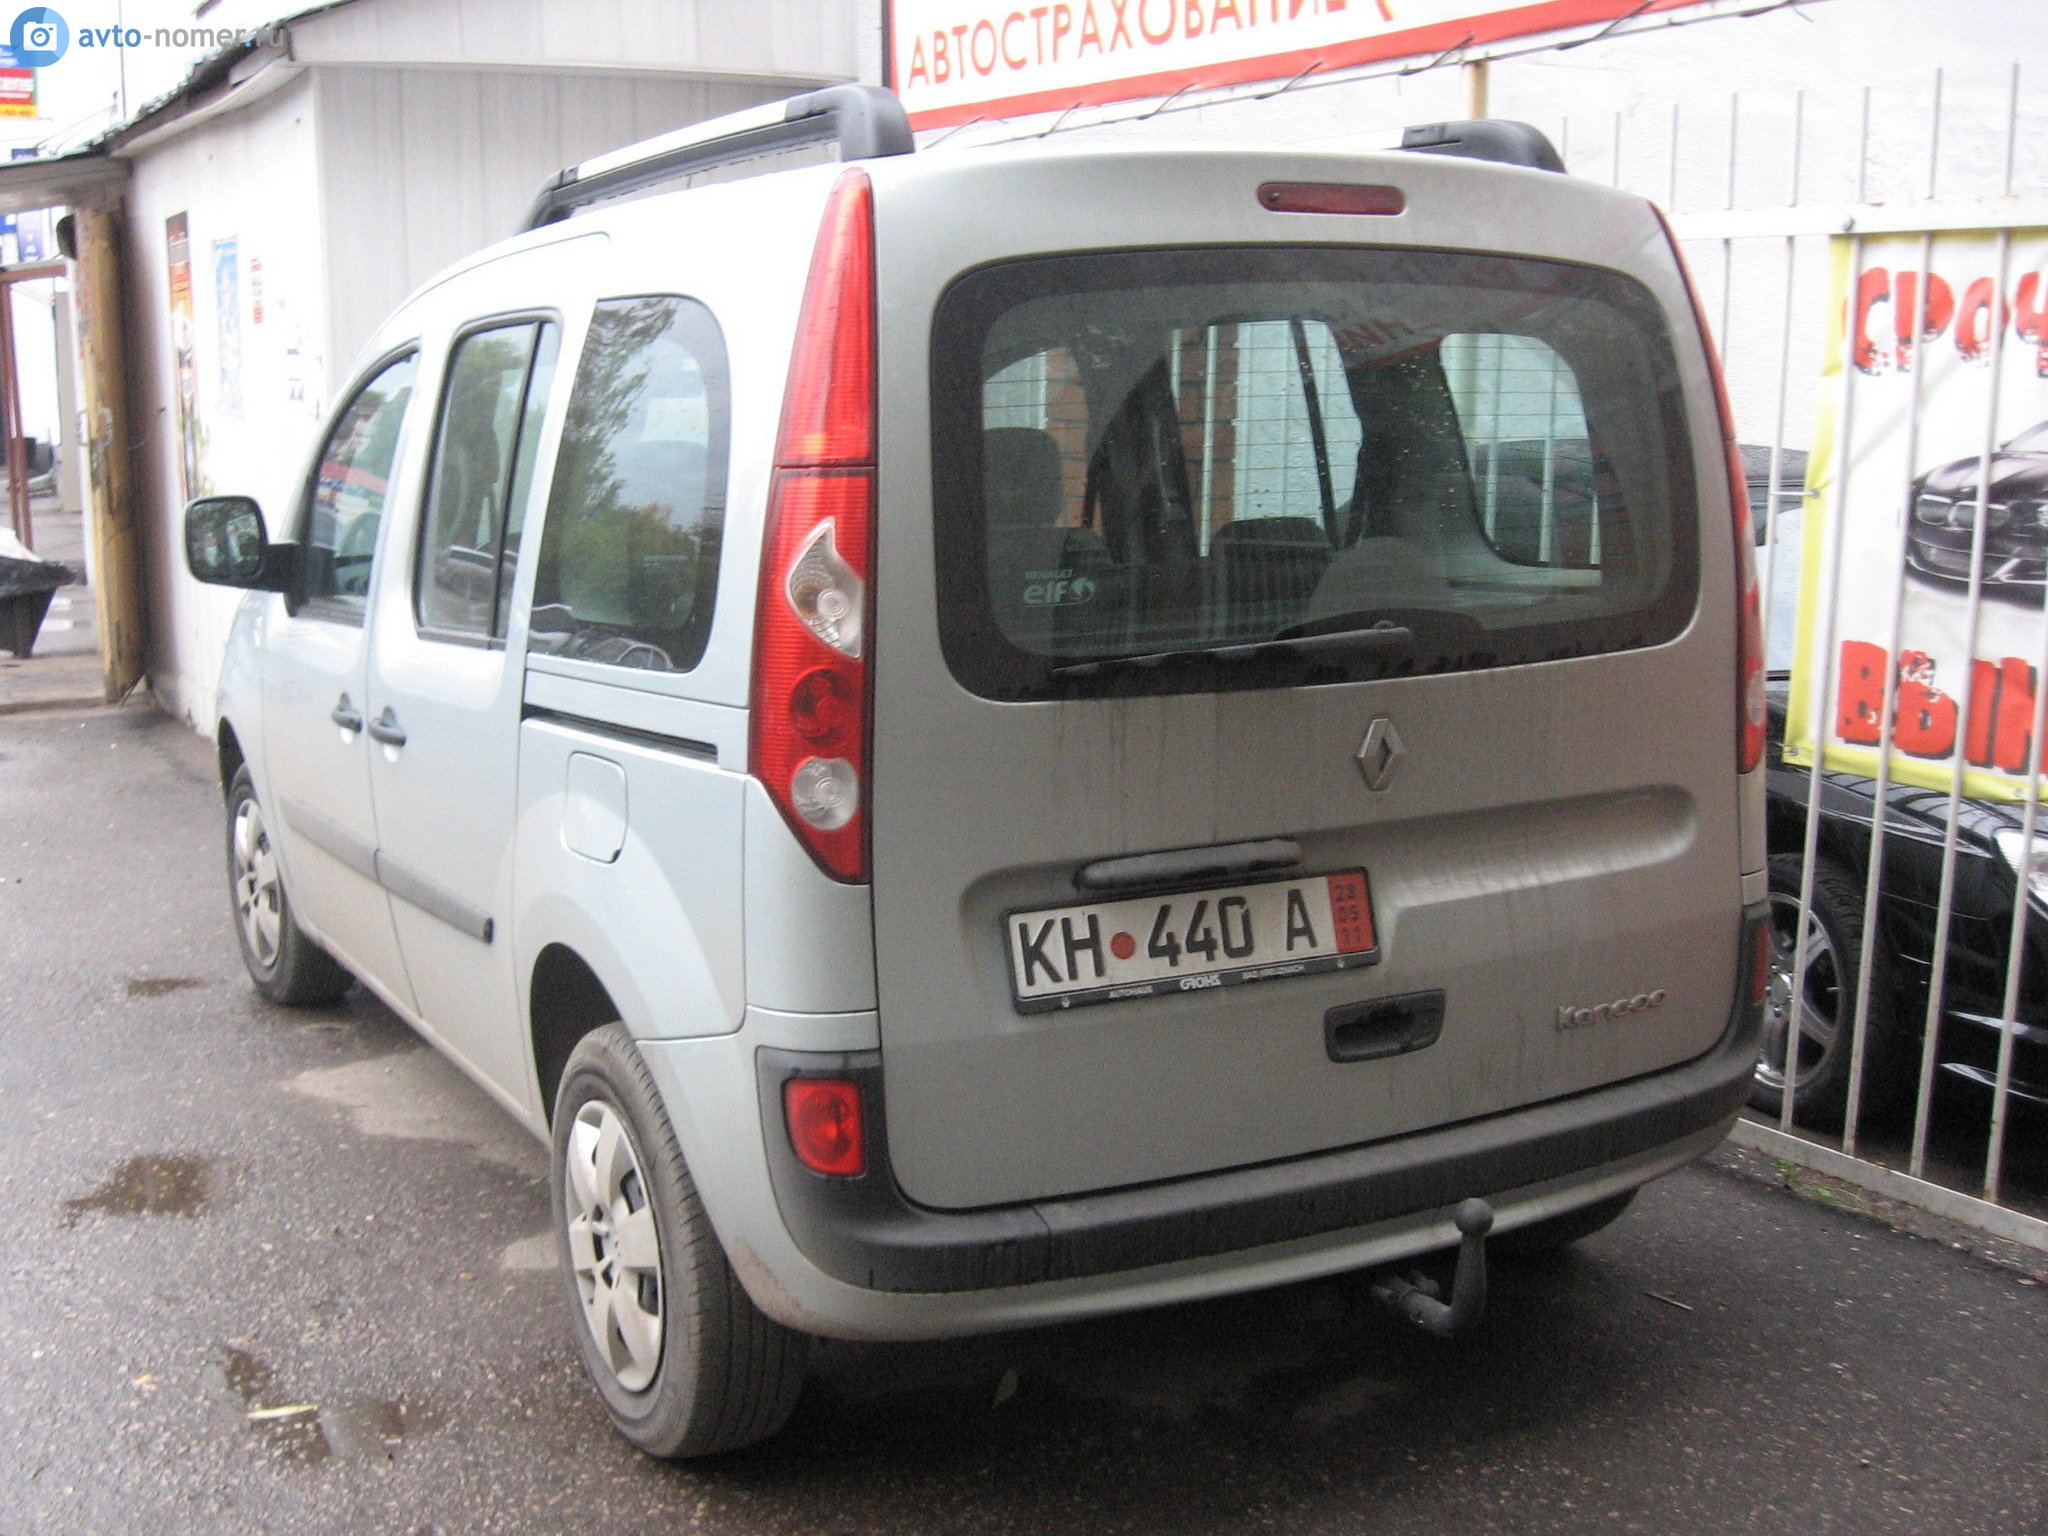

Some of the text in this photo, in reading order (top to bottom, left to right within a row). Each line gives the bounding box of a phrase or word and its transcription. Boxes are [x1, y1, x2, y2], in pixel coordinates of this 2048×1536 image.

[906, 0, 1346, 89] АВТОСТРАХОВА
[1018, 888, 1319, 986] KH 440 A
